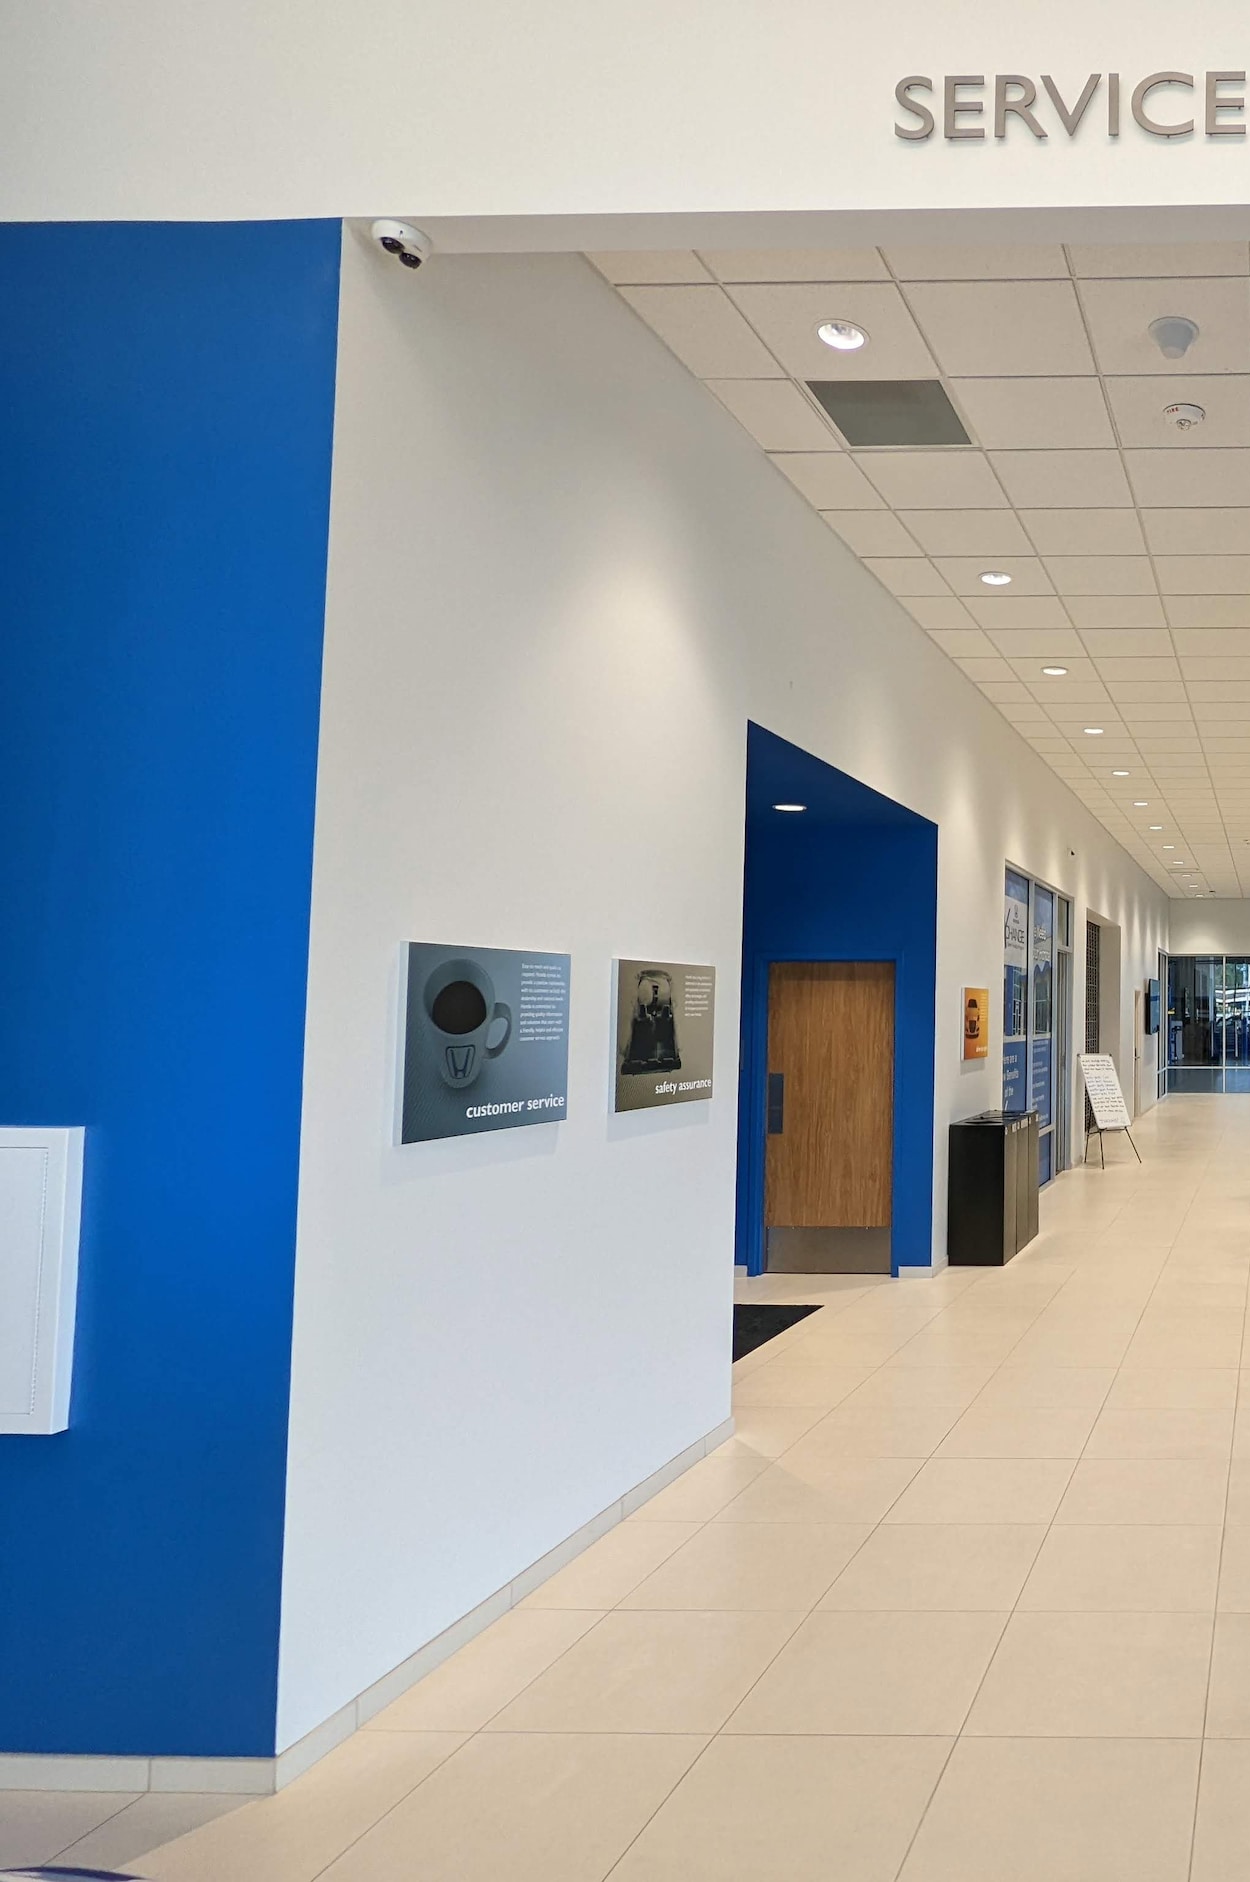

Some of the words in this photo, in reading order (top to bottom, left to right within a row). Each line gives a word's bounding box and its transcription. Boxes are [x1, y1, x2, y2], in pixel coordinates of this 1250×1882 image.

[894, 71, 1247, 139] SERVICE
[655, 1080, 677, 1095] safety
[678, 1079, 712, 1091] assurance
[466, 1100, 525, 1119] customer
[526, 1093, 565, 1111] service
